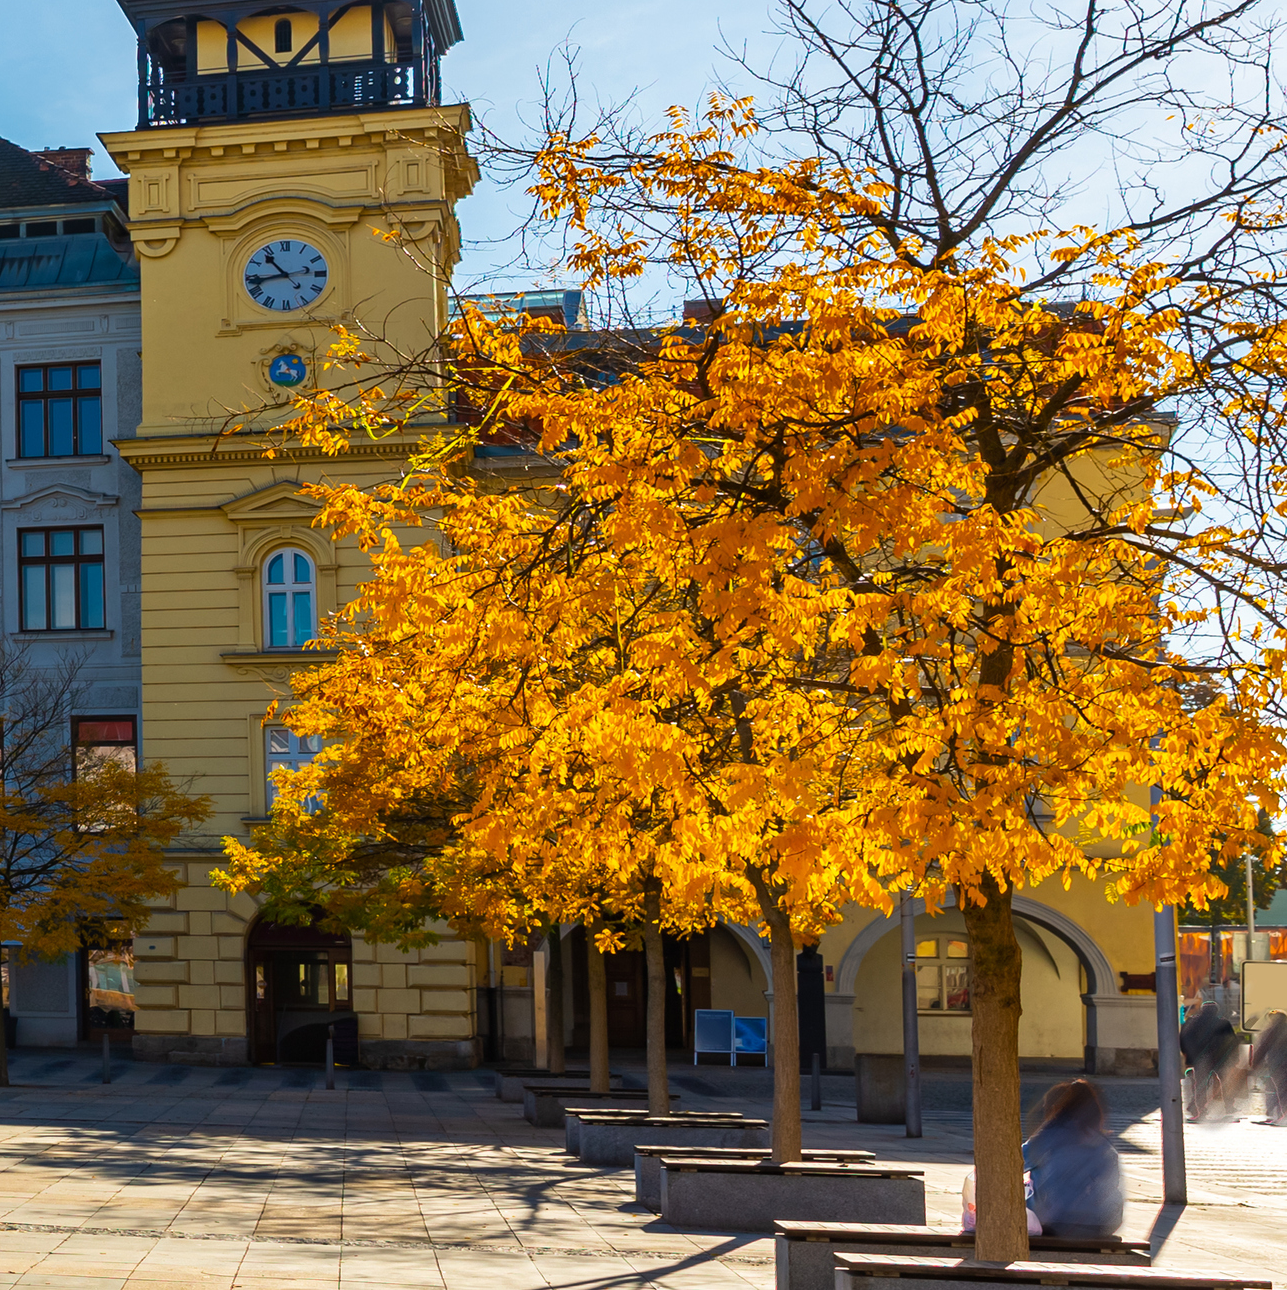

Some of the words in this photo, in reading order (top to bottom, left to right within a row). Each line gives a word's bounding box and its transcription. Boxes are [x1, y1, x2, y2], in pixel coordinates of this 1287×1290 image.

[262, 245, 274, 256] XI
[280, 241, 291, 252] XII
[249, 258, 262, 267] X
